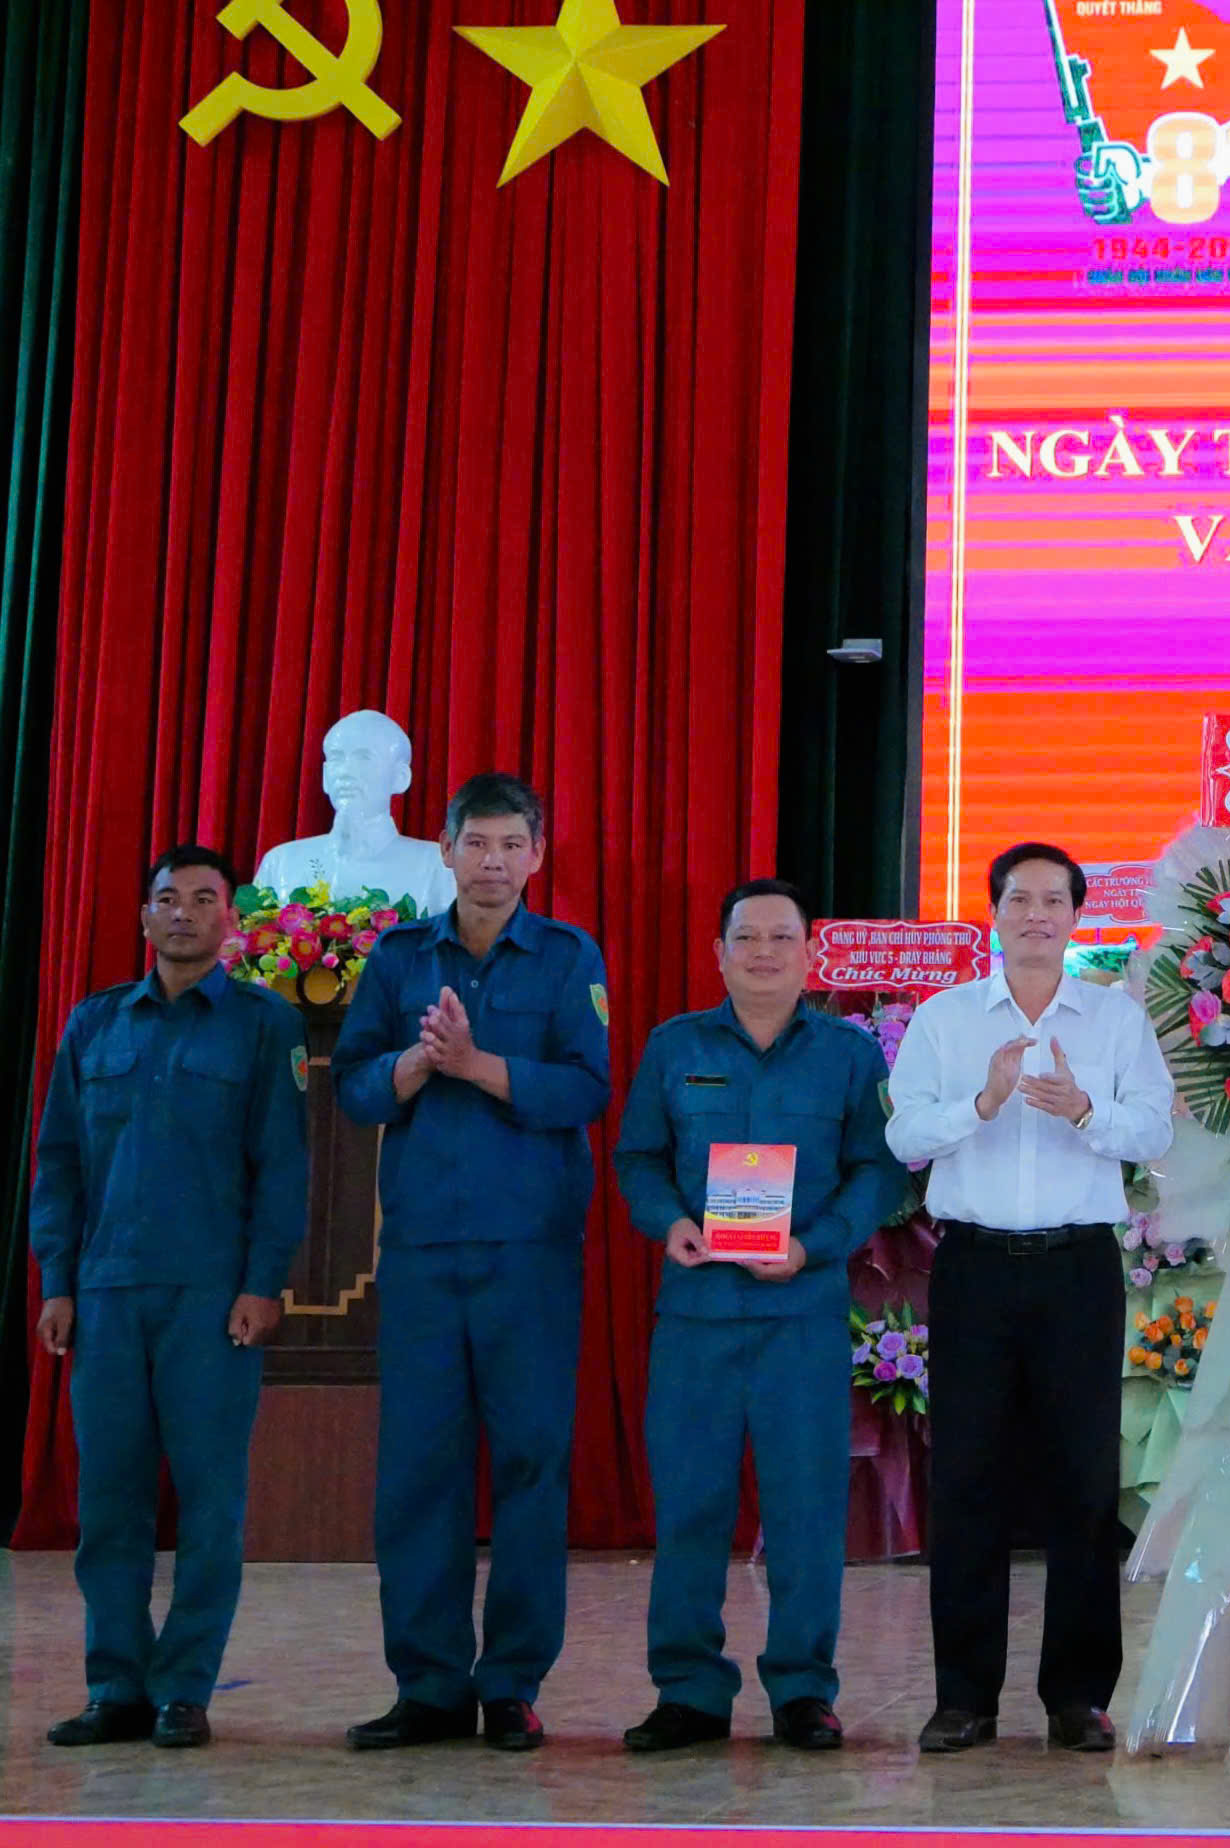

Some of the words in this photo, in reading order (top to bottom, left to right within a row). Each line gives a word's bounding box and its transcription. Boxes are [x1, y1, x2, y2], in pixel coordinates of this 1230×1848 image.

[989, 416, 1195, 477] NGÀY
[888, 951, 894, 964] 5
[832, 967, 886, 980] Chúc
[890, 967, 957, 984] Mừng
